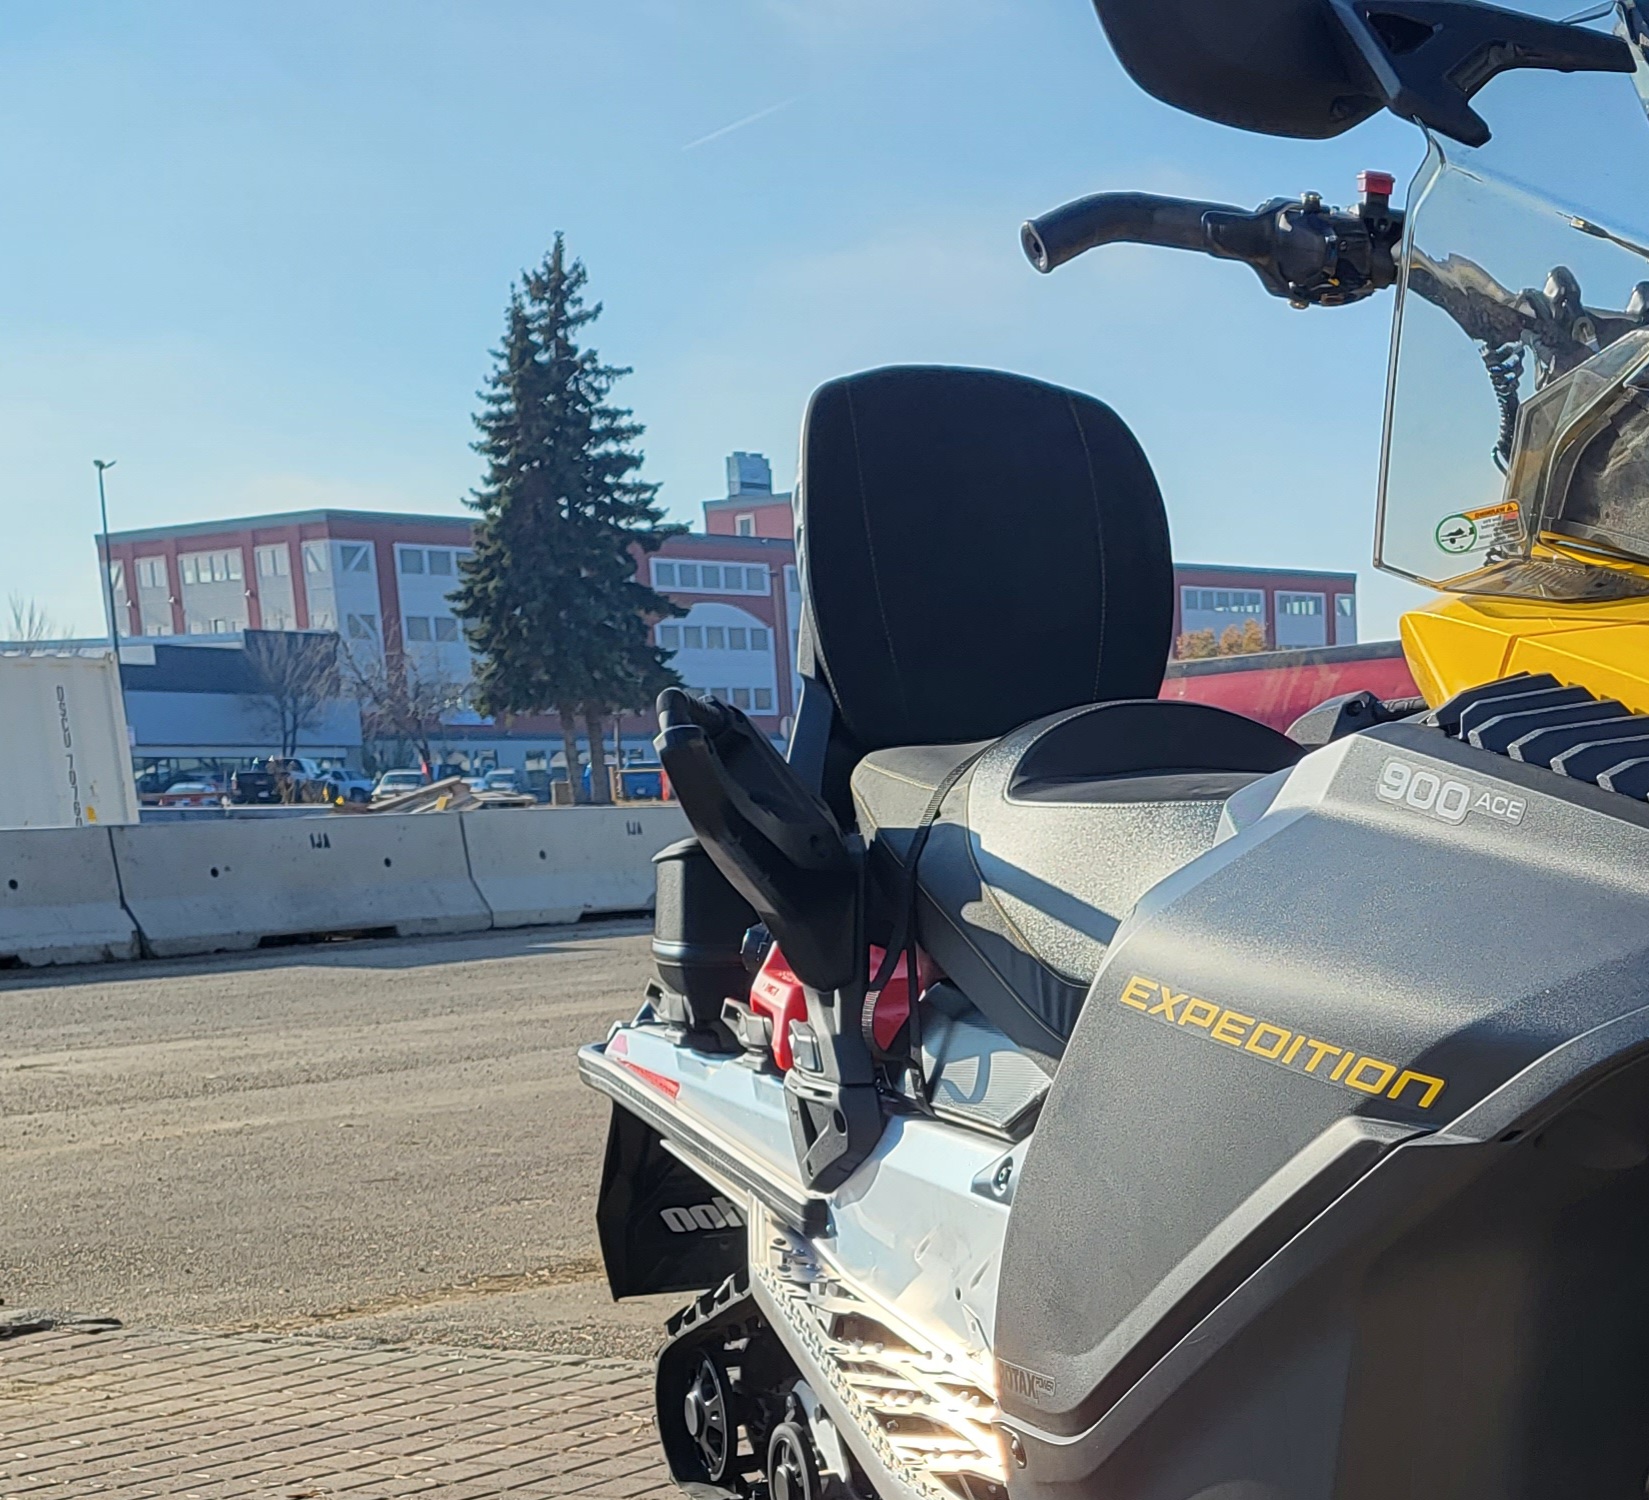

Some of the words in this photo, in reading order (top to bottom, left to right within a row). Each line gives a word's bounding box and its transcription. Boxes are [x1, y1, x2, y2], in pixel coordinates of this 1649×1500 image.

[1378, 761, 1471, 820] 900
[1474, 792, 1524, 820] ACE
[1119, 974, 1446, 1109] EXPEDITION
